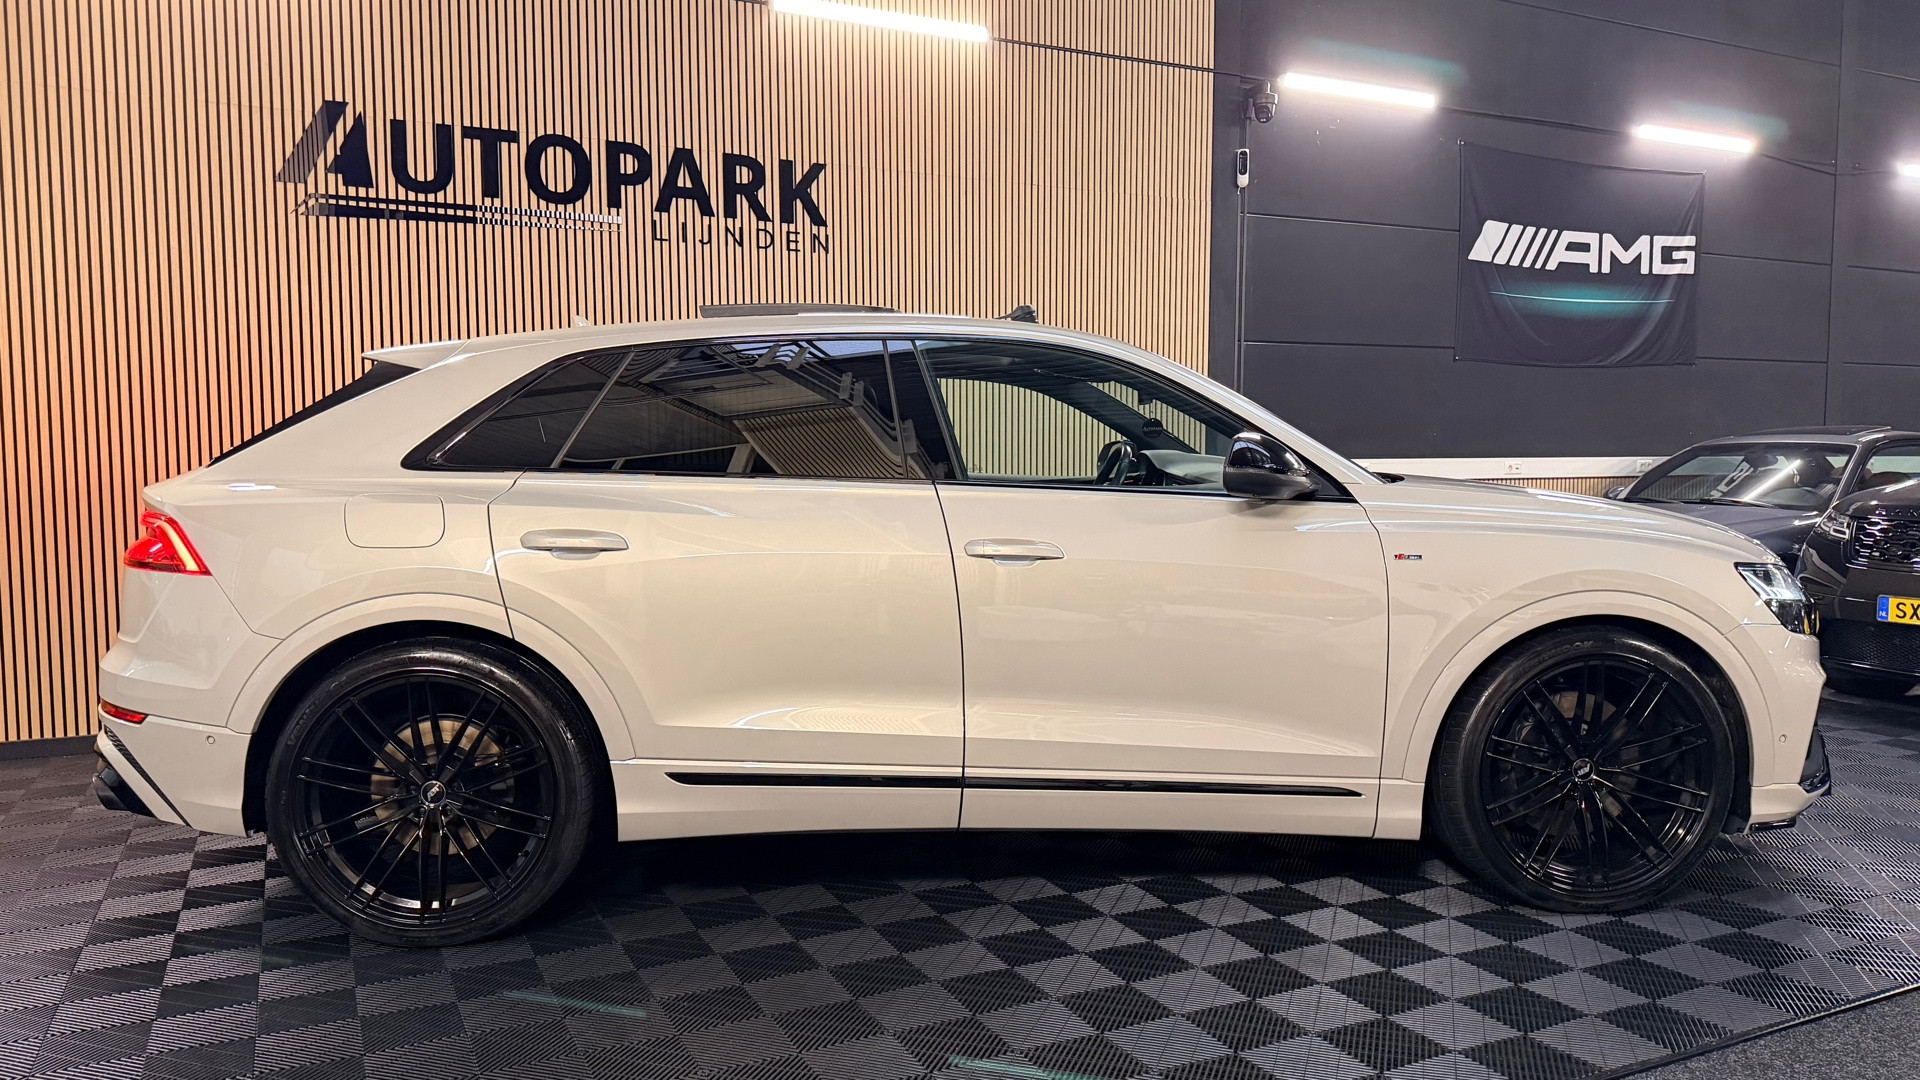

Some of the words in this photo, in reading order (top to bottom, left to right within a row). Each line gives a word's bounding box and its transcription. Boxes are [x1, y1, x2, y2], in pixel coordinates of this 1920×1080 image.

[275, 99, 829, 228] AUTOPARK
[653, 218, 830, 255] LIJNDEN
[1545, 230, 1697, 275] AMG
[1895, 601, 1920, 621] SX
